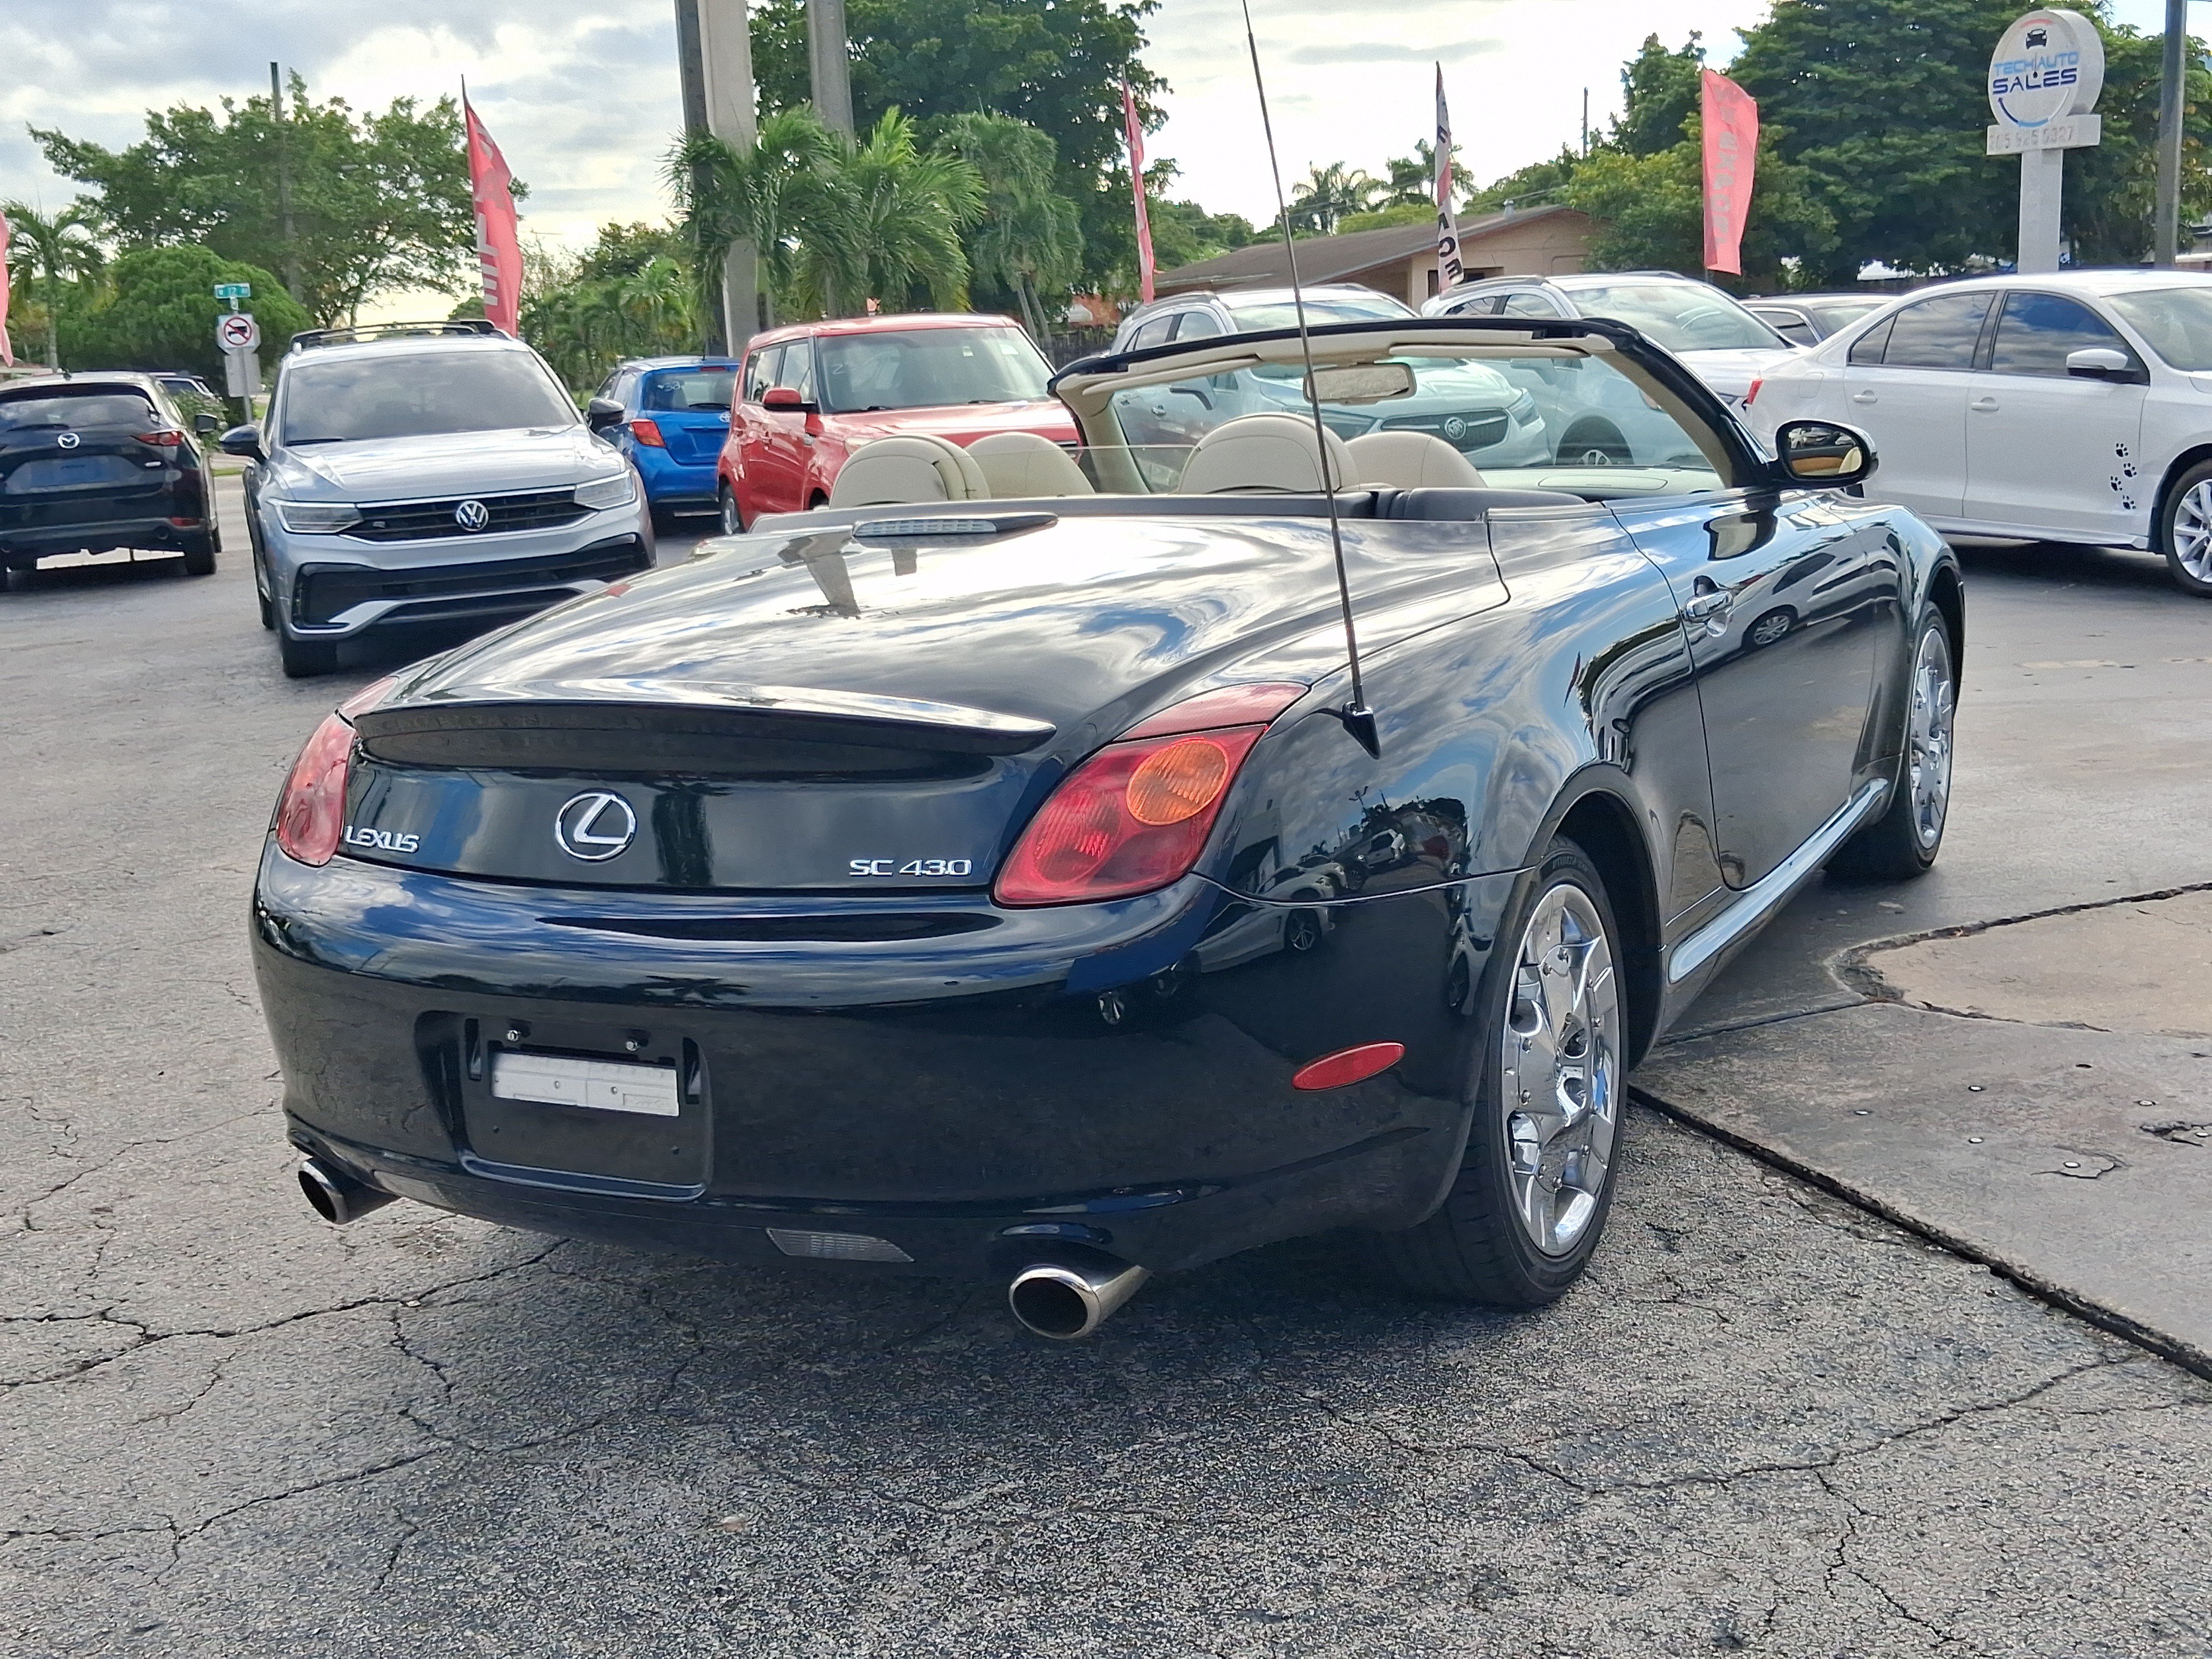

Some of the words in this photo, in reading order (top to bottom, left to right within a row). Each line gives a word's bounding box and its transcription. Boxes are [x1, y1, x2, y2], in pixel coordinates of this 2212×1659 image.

[1992, 68, 2077, 95] SALES
[345, 825, 420, 853] LEXUS
[848, 859, 894, 877] SC
[898, 859, 973, 877] 430
